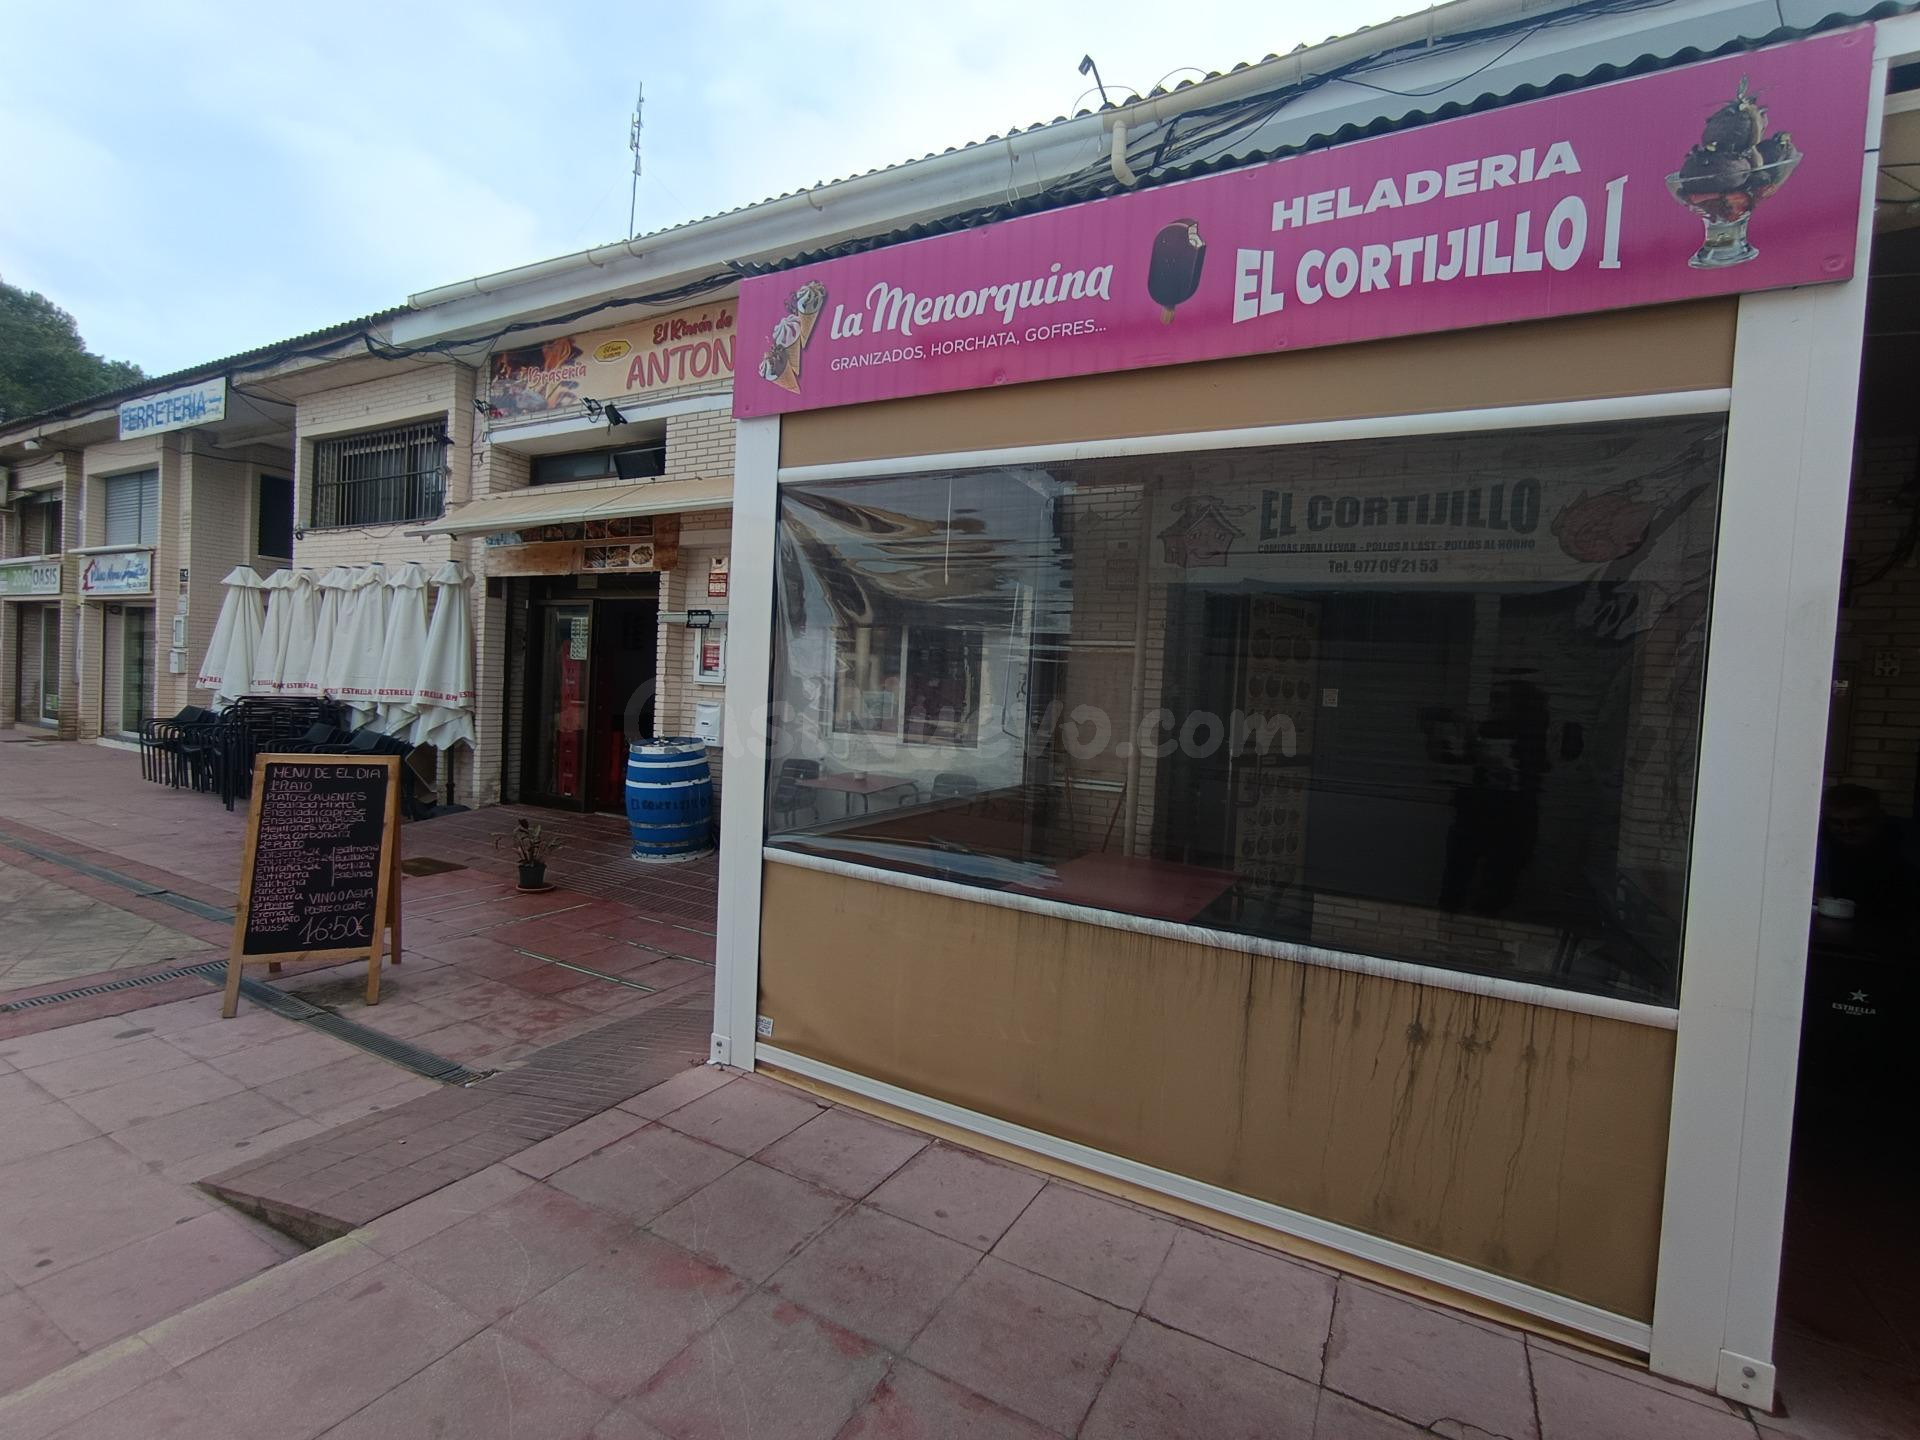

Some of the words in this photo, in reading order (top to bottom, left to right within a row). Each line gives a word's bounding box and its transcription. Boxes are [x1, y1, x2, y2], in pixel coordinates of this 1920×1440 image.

[1272, 140, 1582, 231] HELADERIA
[1233, 248, 1284, 324] EL
[1295, 195, 1588, 305] CORTIJILLO
[831, 304, 863, 340] la
[866, 263, 1114, 336] Menorquina
[653, 322, 669, 344] El
[716, 309, 733, 330] de
[831, 346, 927, 371] GRANIZADOS,
[931, 332, 1020, 357] HORCHATA,
[1025, 319, 1107, 342] GOFRES...
[1260, 490, 1296, 542] EL
[1307, 478, 1540, 535] CORTIJILLO
[1258, 543, 1297, 553] COMIDAS
[1300, 543, 1324, 552] PARA
[1325, 542, 1356, 552] LLEVAR
[1366, 542, 1401, 552] POLLOS
[1445, 540, 1482, 550] POLLOS
[1498, 538, 1536, 550] HORNO
[1354, 560, 1380, 573] 977
[33, 567, 58, 585] OASIS
[273, 767, 311, 779] MENU
[314, 768, 332, 779] DE
[336, 767, 354, 779] EL
[356, 768, 381, 779] DIA
[280, 780, 313, 791] PLATO
[266, 793, 306, 801] PLATOS
[273, 840, 305, 848] PLATO
[309, 891, 336, 904] VINO
[1831, 1002, 1877, 1015] ESTRELLA
